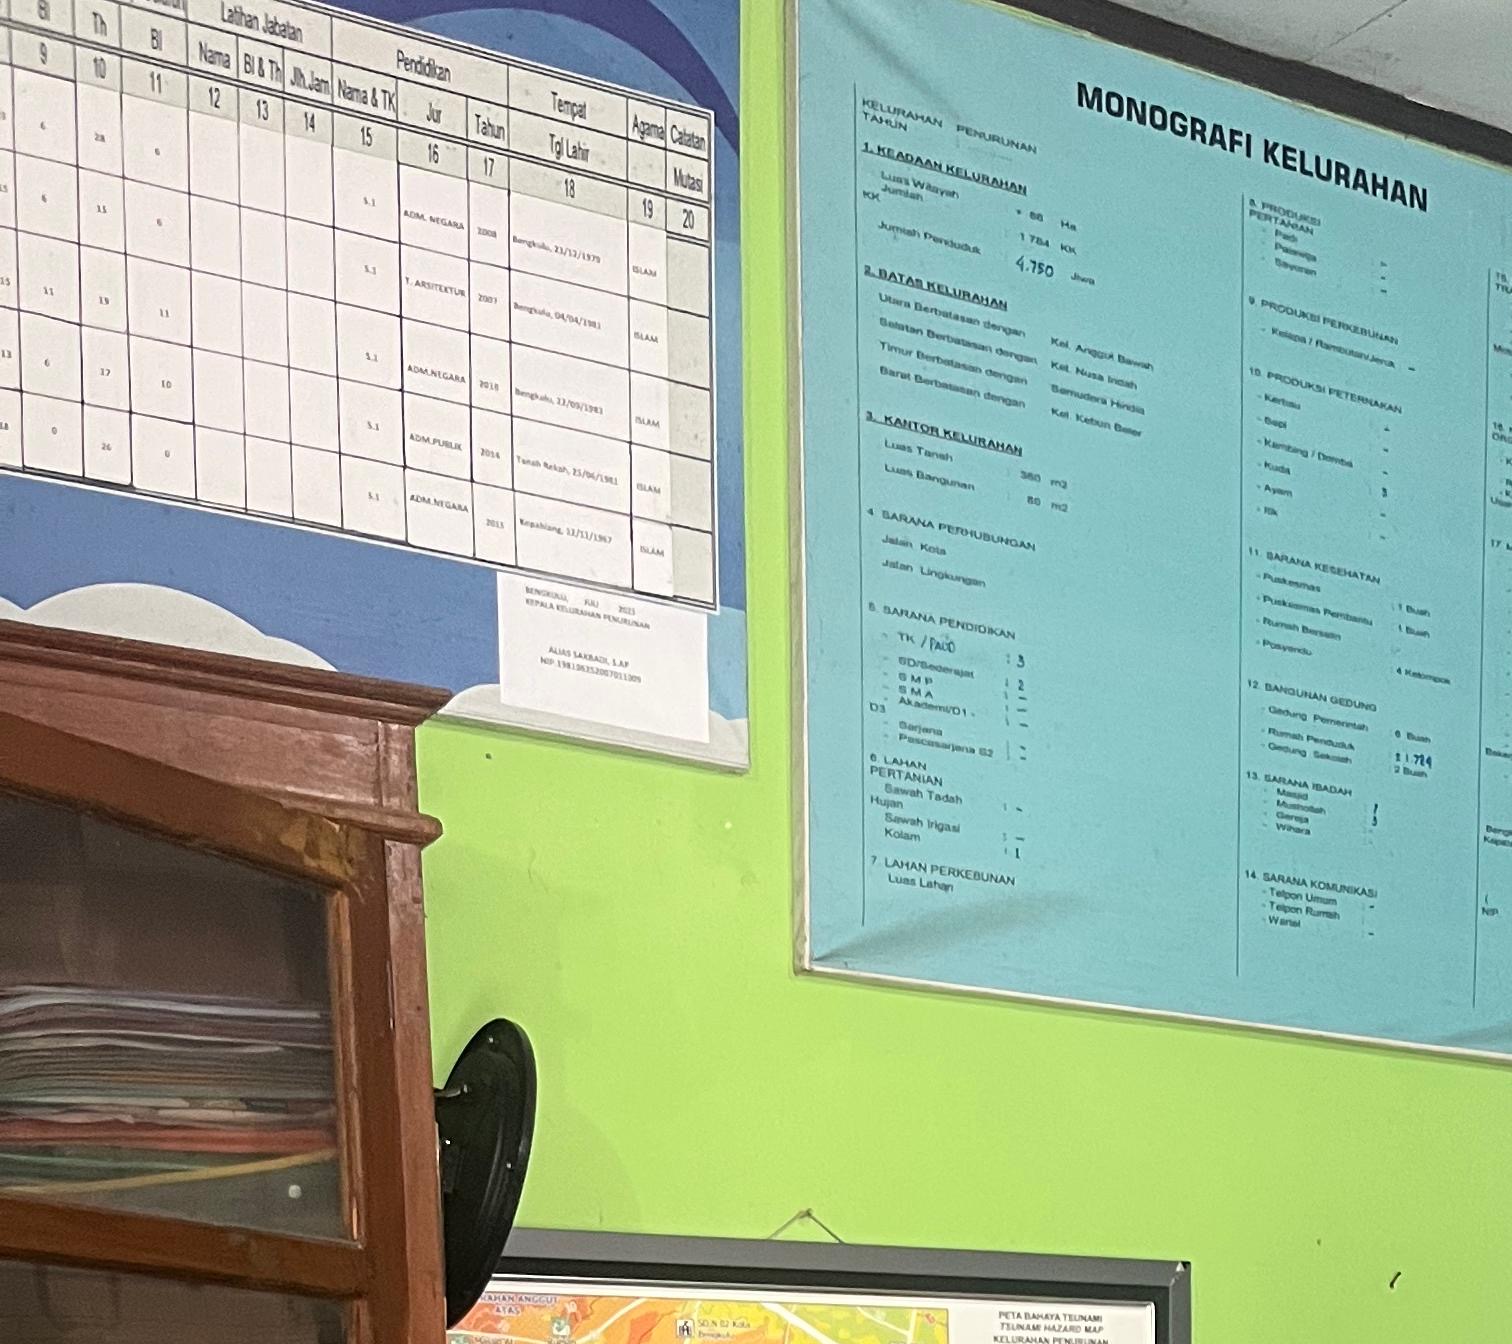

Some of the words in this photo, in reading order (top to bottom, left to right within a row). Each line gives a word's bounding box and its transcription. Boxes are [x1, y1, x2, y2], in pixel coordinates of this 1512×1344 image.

[221, 3, 260, 34] Latihan
[262, 14, 303, 43] Jabatan
[199, 41, 231, 70] Nama
[267, 59, 283, 83] Th
[338, 78, 368, 106] Nama
[381, 88, 397, 113] TK
[397, 49, 451, 83] Pendidikan
[40, 42, 48, 64] 9
[93, 56, 107, 79] 10
[150, 70, 163, 94] 11
[208, 87, 221, 110] 12
[256, 97, 270, 121] 13
[304, 110, 316, 133] 14
[360, 125, 373, 148] 15
[427, 141, 440, 164] 16
[483, 156, 495, 177] 17
[564, 177, 575, 199] 18
[642, 198, 653, 220] 19
[682, 208, 695, 230] 20
[426, 102, 442, 125] Jur
[475, 113, 506, 141] Tahun
[551, 91, 587, 122] Tempat
[632, 114, 665, 140] Agama
[670, 124, 706, 152] Catatan
[861, 99, 943, 130] KELURAHAN
[956, 123, 1038, 156] PENURUNAN
[862, 111, 908, 133] TAHUN
[1076, 81, 1253, 160] MONOGRAFI
[1262, 139, 1429, 213] KELURAHAN
[550, 133, 564, 159] Tgl
[565, 138, 589, 162] Lahir
[673, 166, 704, 194] Mutasi
[877, 145, 942, 176] KEADAAN
[945, 161, 1028, 197] KELURAHAN
[1015, 255, 1055, 278] 4.750
[926, 280, 1008, 312] KELURAHAN
[878, 292, 911, 310] Utara
[982, 318, 1026, 338] dengan
[879, 365, 911, 382] Barat
[914, 374, 981, 399] Berbatasan
[983, 391, 1026, 409] dengan
[884, 414, 939, 438] KANTOR
[942, 428, 1023, 458] KELURAHAN
[884, 439, 913, 454] Luas
[917, 446, 953, 463] Tanah
[884, 463, 913, 478] Luas
[916, 471, 975, 492] Bangunan
[882, 510, 934, 530] SARANA
[938, 522, 1036, 552] PERHUBUNGAN
[882, 534, 913, 549] Jalan
[920, 543, 946, 556] Kota
[882, 558, 913, 573] Jalan
[920, 566, 986, 588] Lingkungan
[1314, 562, 1381, 585] KESEHATAN
[883, 605, 936, 626] SARANA
[939, 616, 1016, 641] PENDIDIKAN
[1265, 682, 1327, 703] BANGUNAN
[1329, 696, 1377, 713] GEDUNG
[870, 766, 943, 787] PERTANIAN
[884, 756, 927, 771] LAHAN
[884, 828, 921, 842] Kolam
[884, 858, 927, 873] LAHAN
[930, 864, 1016, 887] PERKEBUNAN
[998, 1311, 1022, 1321] PETA
[1024, 1312, 1060, 1322] BAHAYA
[1062, 1313, 1103, 1323] TSUNAMI
[1084, 1326, 1104, 1334] MAP
[993, 1335, 1050, 1344] KELURAHAN
